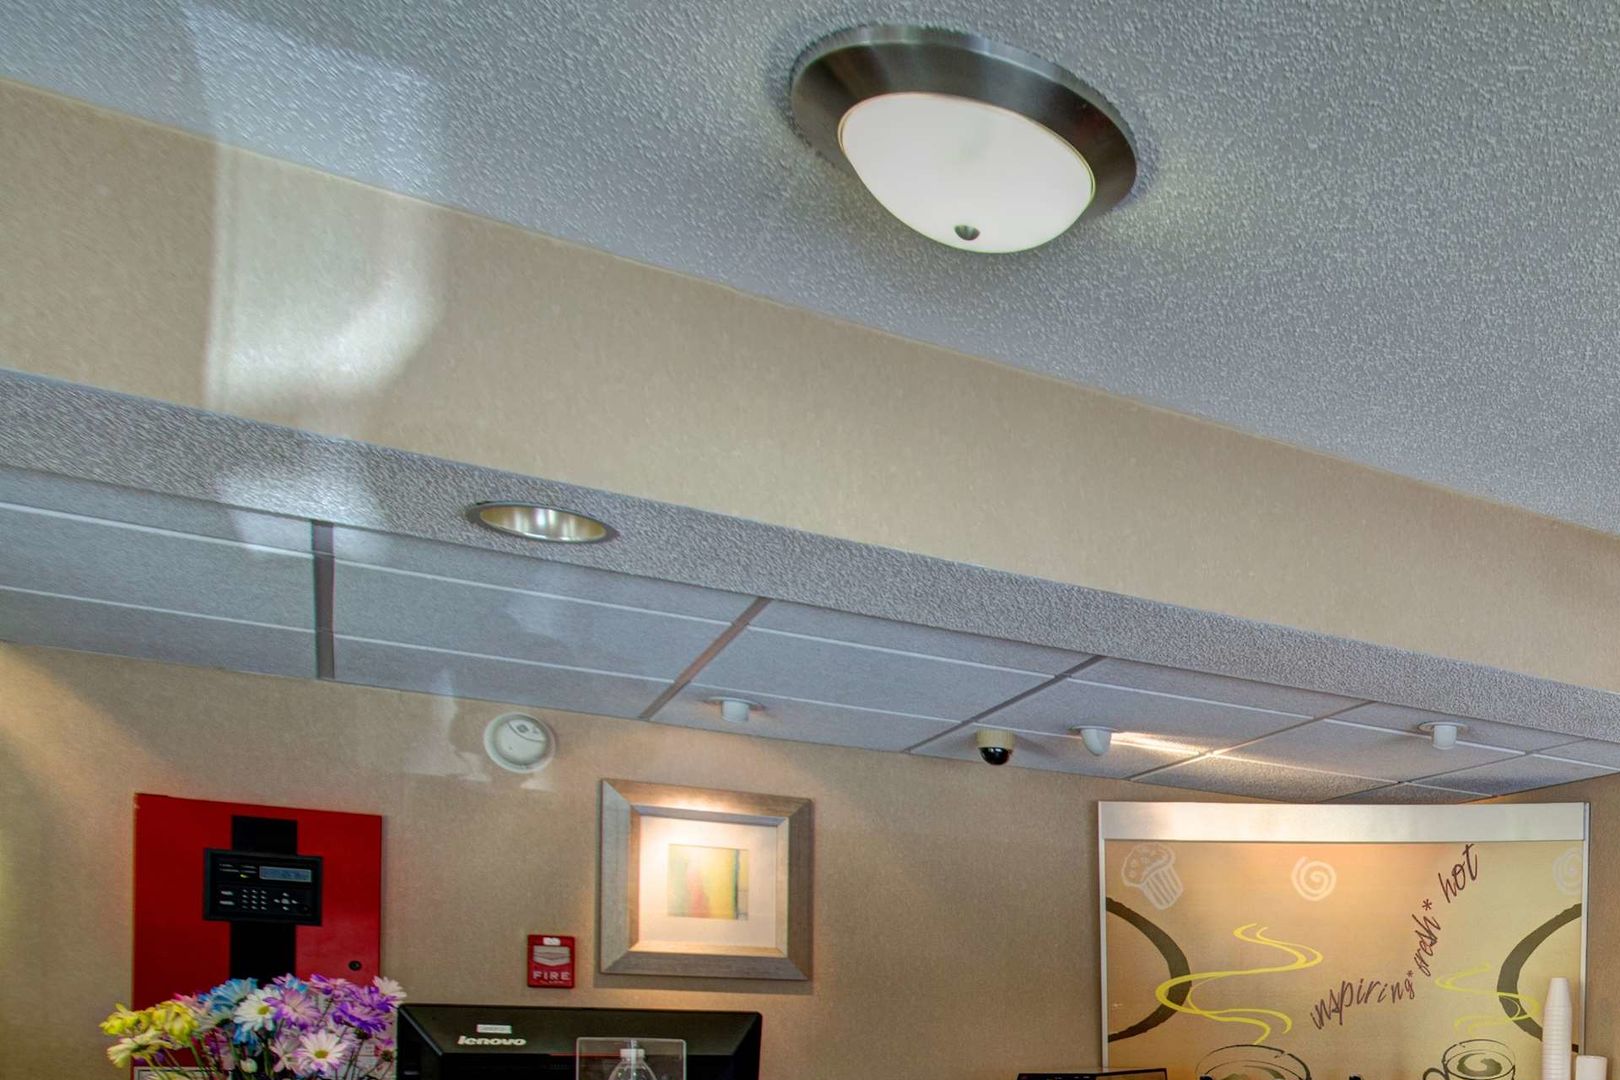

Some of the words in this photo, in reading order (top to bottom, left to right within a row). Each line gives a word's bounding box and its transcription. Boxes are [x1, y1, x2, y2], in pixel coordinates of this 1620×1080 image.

[1438, 843, 1478, 903] hot
[532, 970, 571, 981] FIRE
[457, 1035, 527, 1046] lenovo
